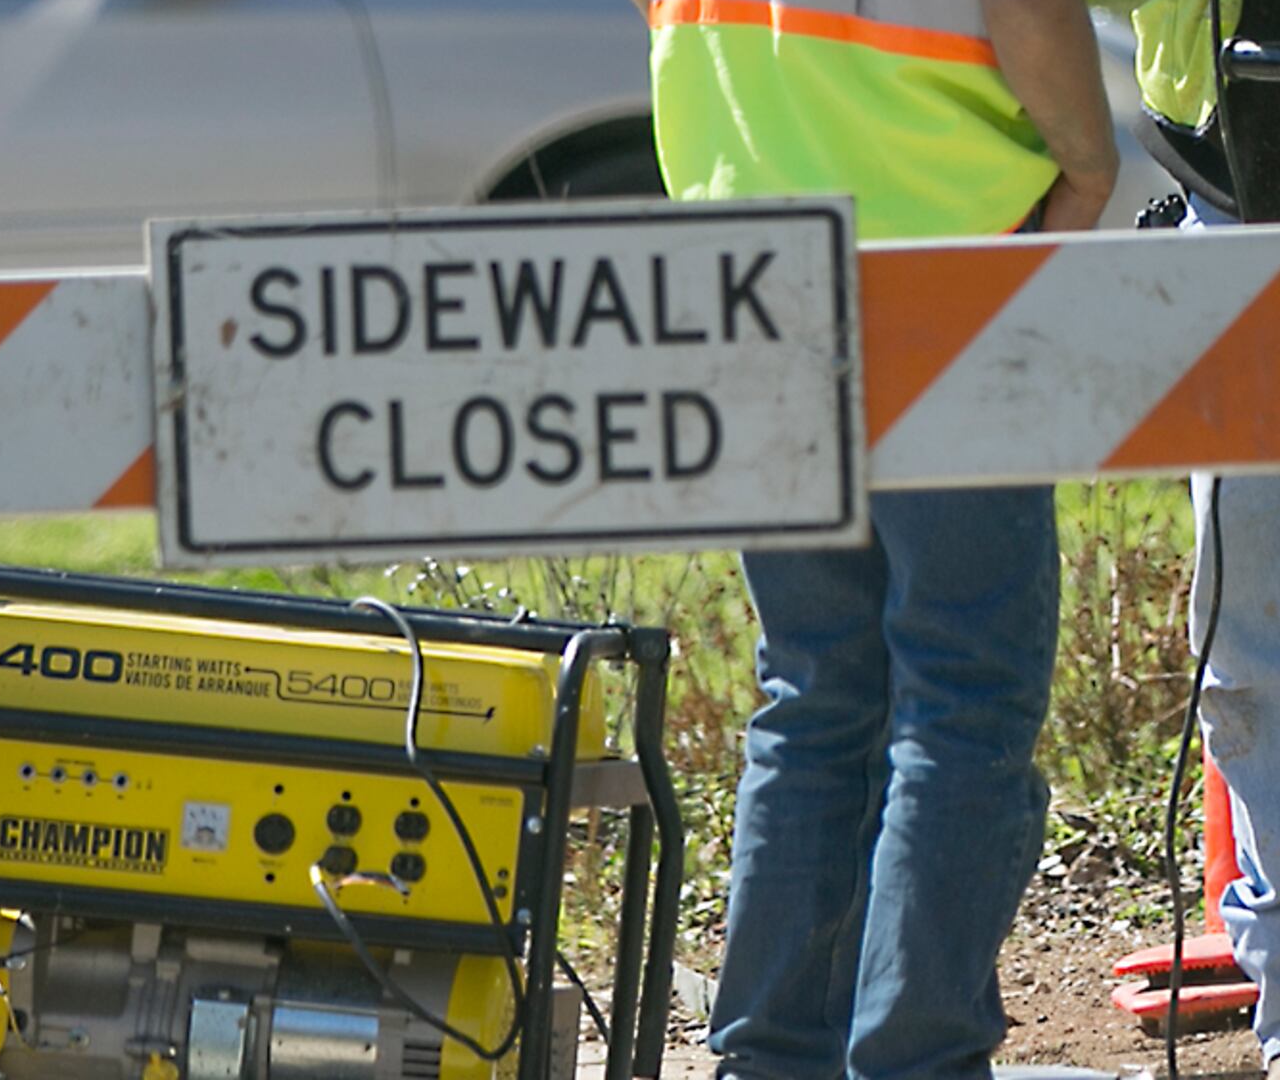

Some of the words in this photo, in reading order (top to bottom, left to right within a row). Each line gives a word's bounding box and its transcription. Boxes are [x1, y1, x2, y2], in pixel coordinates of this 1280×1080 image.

[249, 251, 781, 358] SIDEWALK
[320, 390, 723, 492] CLOSED
[126, 651, 191, 672] STARTING
[196, 659, 242, 677] WATTS
[124, 672, 169, 689] VATIOS
[174, 674, 193, 691] DE
[197, 679, 270, 698] ARRANQUE
[287, 671, 395, 702] 5400
[0, 818, 166, 863] CHAMPION
